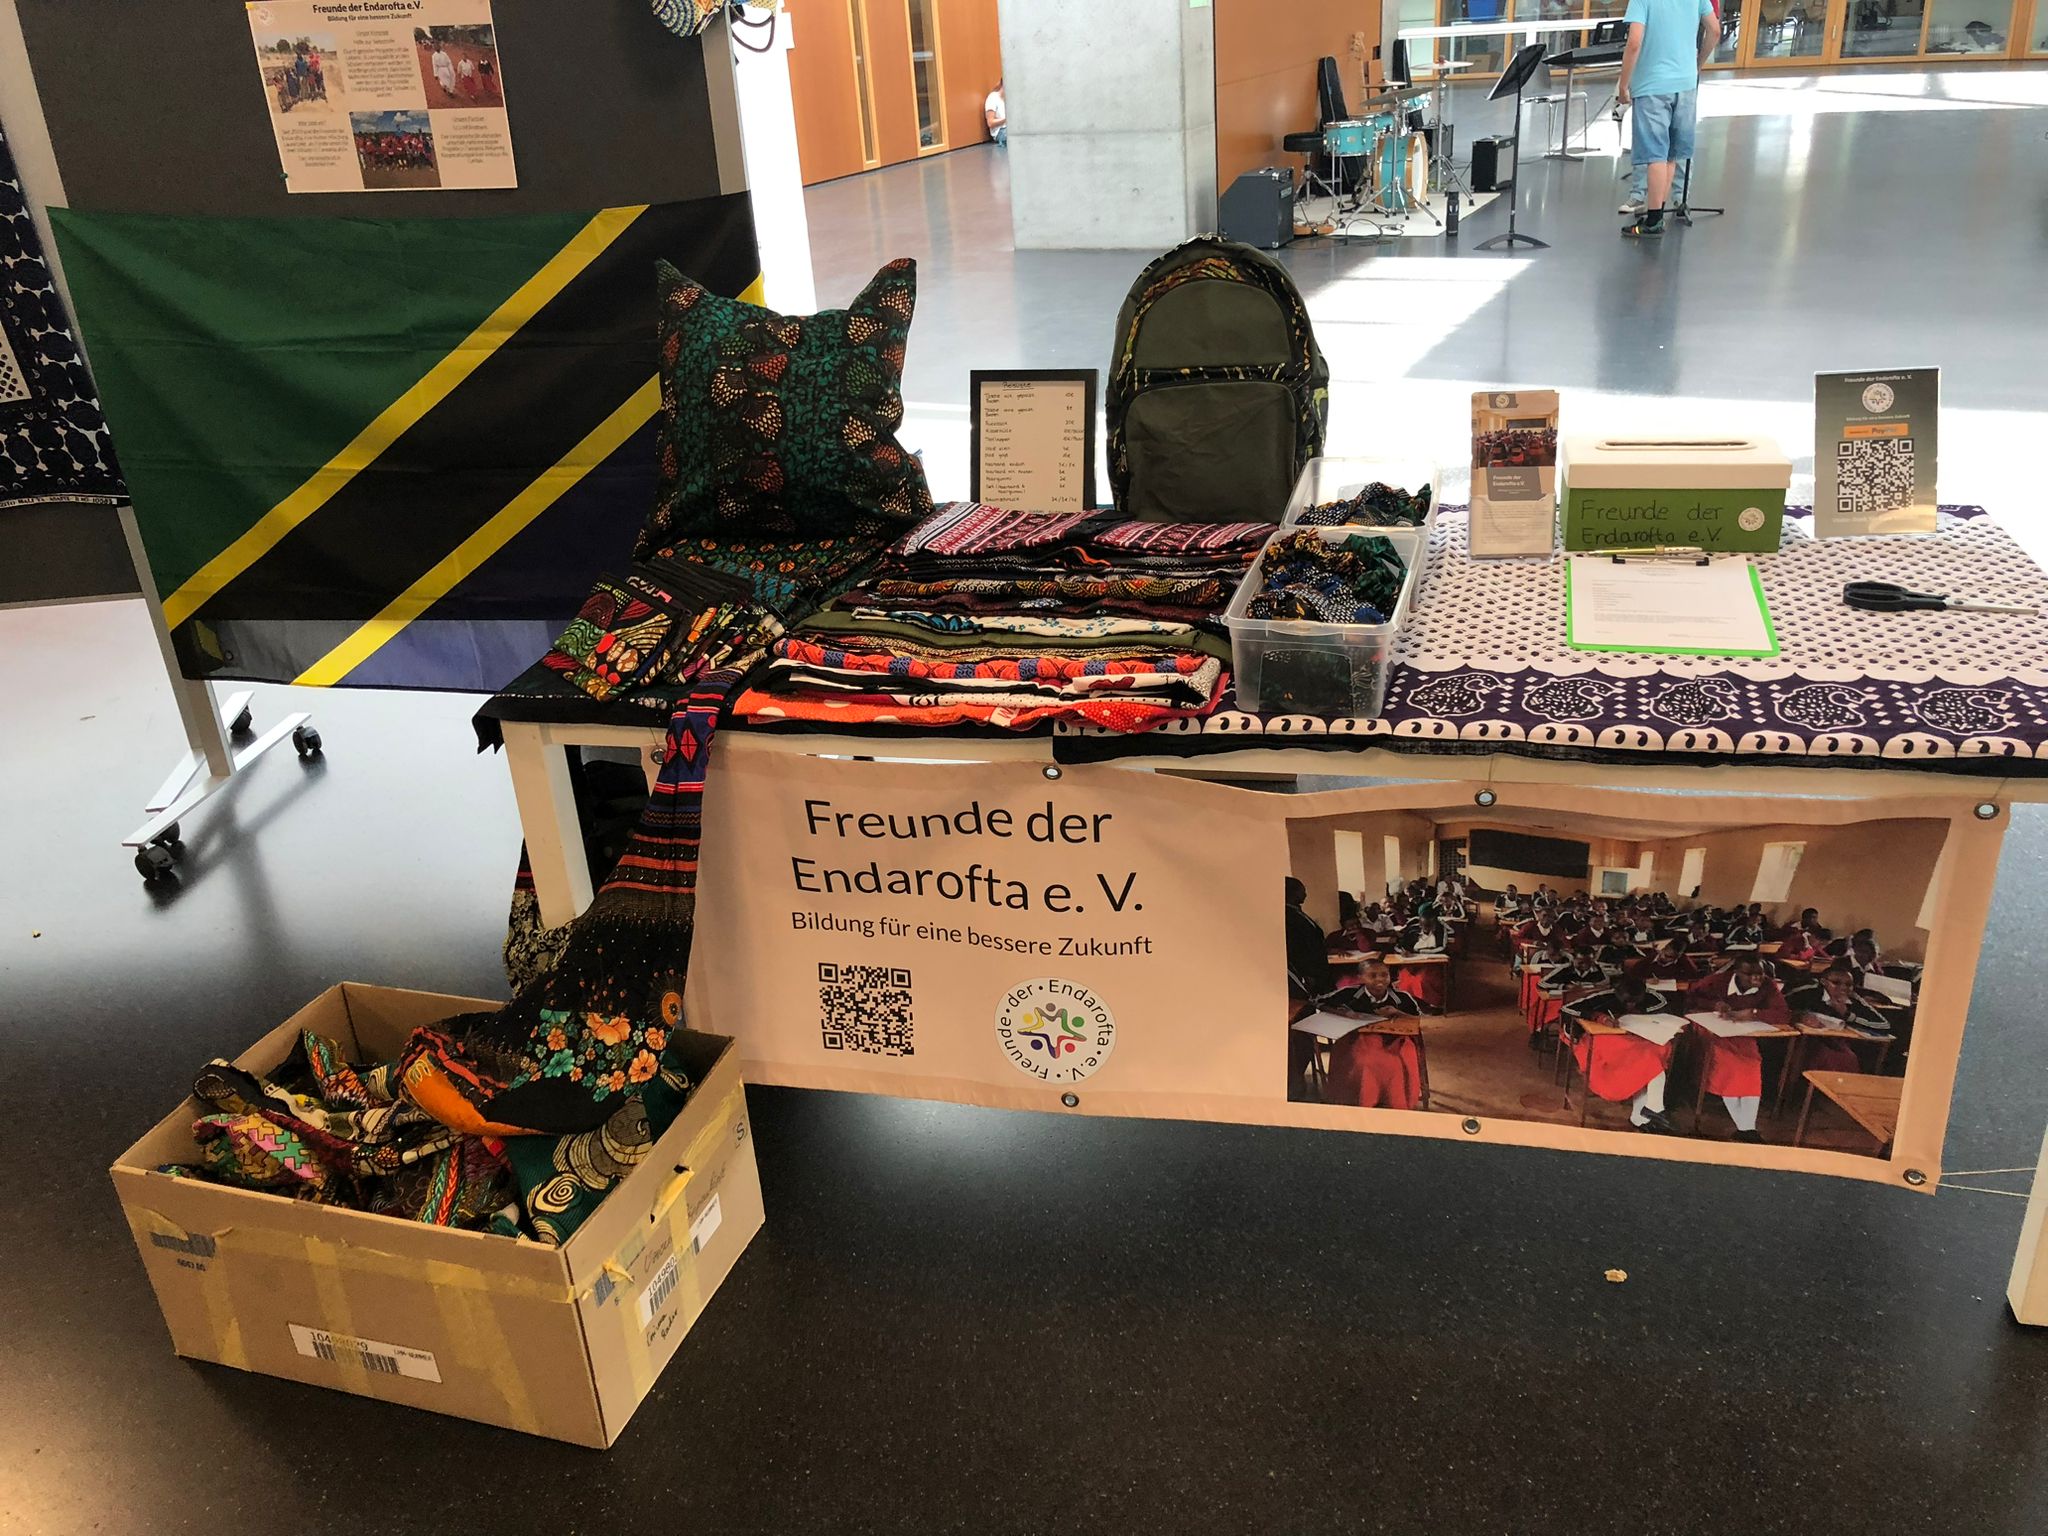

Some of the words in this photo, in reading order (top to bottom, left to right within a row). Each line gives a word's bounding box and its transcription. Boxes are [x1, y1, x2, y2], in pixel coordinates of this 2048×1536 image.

[312, 4, 348, 14] Freunde
[348, 3, 362, 12] der
[363, 1, 406, 12] Endarofta
[1580, 499, 1669, 521] Freunde
[1686, 503, 1724, 521] der
[805, 800, 1013, 839] Freunde
[1026, 801, 1113, 843] der
[791, 857, 1030, 911] Endarofta
[1043, 881, 1085, 912] e.
[1096, 872, 1143, 912] V.
[791, 911, 875, 937] Bildung
[878, 917, 911, 937] für
[916, 921, 962, 943] eine
[967, 926, 1052, 955] bessere
[1057, 936, 1153, 956] Zukunft
[1007, 983, 1034, 1010] der
[1048, 979, 1113, 1047] Endarofta
[997, 1015, 1049, 1080] Freunde
